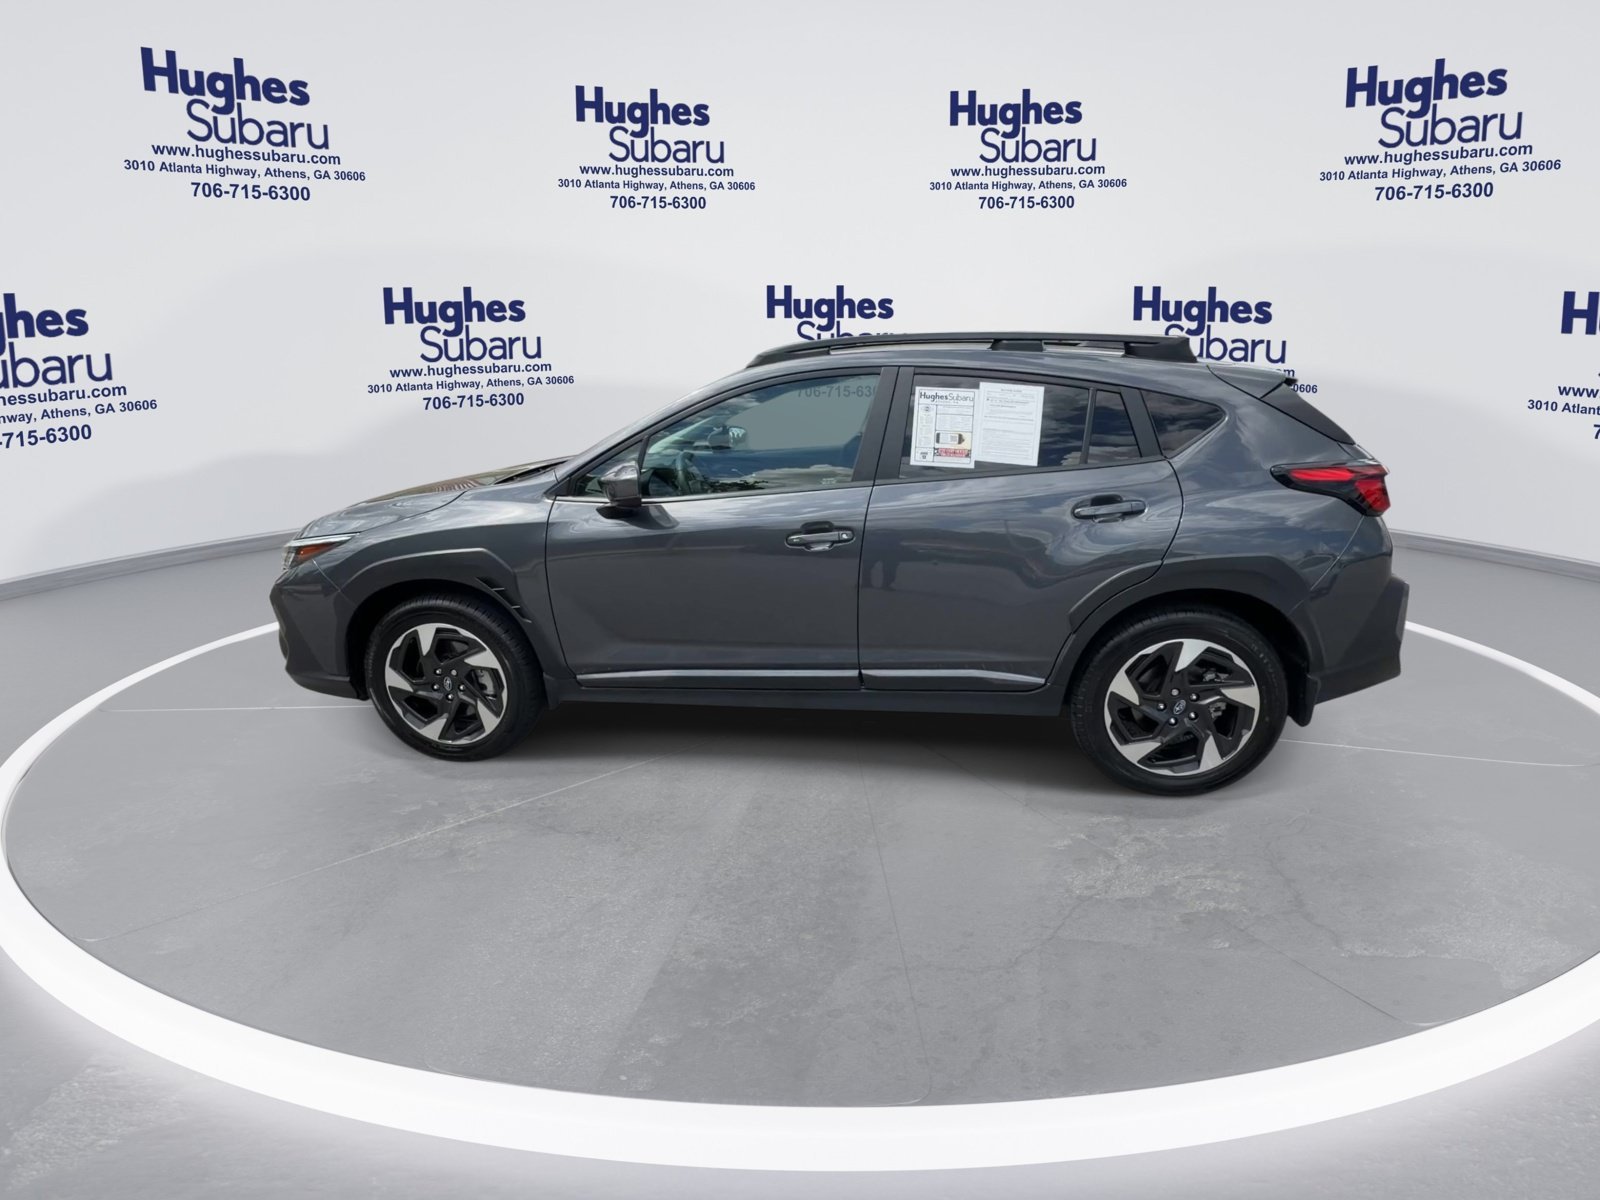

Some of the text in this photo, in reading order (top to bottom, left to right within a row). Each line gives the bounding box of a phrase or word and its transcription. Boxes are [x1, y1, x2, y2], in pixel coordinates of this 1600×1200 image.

[140, 47, 310, 115] Hughes
[1345, 58, 1507, 119] Hughes
[575, 85, 710, 139] Hughes
[950, 88, 1083, 139] Hughes
[186, 98, 329, 150] Subaru
[1378, 105, 1523, 148] Subaru
[151, 144, 341, 165] www.hughessubaru.com
[609, 126, 724, 164] Subaru
[979, 126, 1096, 163] Subaru
[1344, 145, 1533, 165] www.hughessubaru.com
[124, 159, 366, 182] 3010 Atlanta Highway, Athens, GA 30606
[578, 165, 734, 178] www.hughessubaru.com
[950, 165, 1106, 177] www.hughessubaru.com
[1319, 159, 1562, 181] 3010 Atlanta Highway, Athens, GA 30606
[190, 182, 310, 201] 706-715-6300
[557, 178, 756, 192] 3010 Atlanta Highway, Athens, GA 30606
[929, 179, 1128, 192] 3010 Atlanta Highway, Athens, GA 30606
[1375, 182, 1493, 201] 706-715-6300
[610, 196, 706, 209] 706-715-6300
[979, 196, 1074, 209] 706-715-6300
[383, 286, 526, 338] Hughes
[767, 285, 894, 332] Hughes
[1133, 286, 1272, 336] Hughes
[420, 324, 541, 363] Subaru
[390, 363, 551, 378] www.hughessubaru.com
[368, 375, 575, 393] 3010 Atlanta Highway, Athens, GA 30606
[1293, 383, 1318, 393] 0606
[41, 408, 92, 421] Athens,
[95, 403, 115, 415] GA
[119, 399, 158, 412] 30606
[422, 392, 524, 410] 706-715-6300
[1528, 399, 1558, 412] 3010
